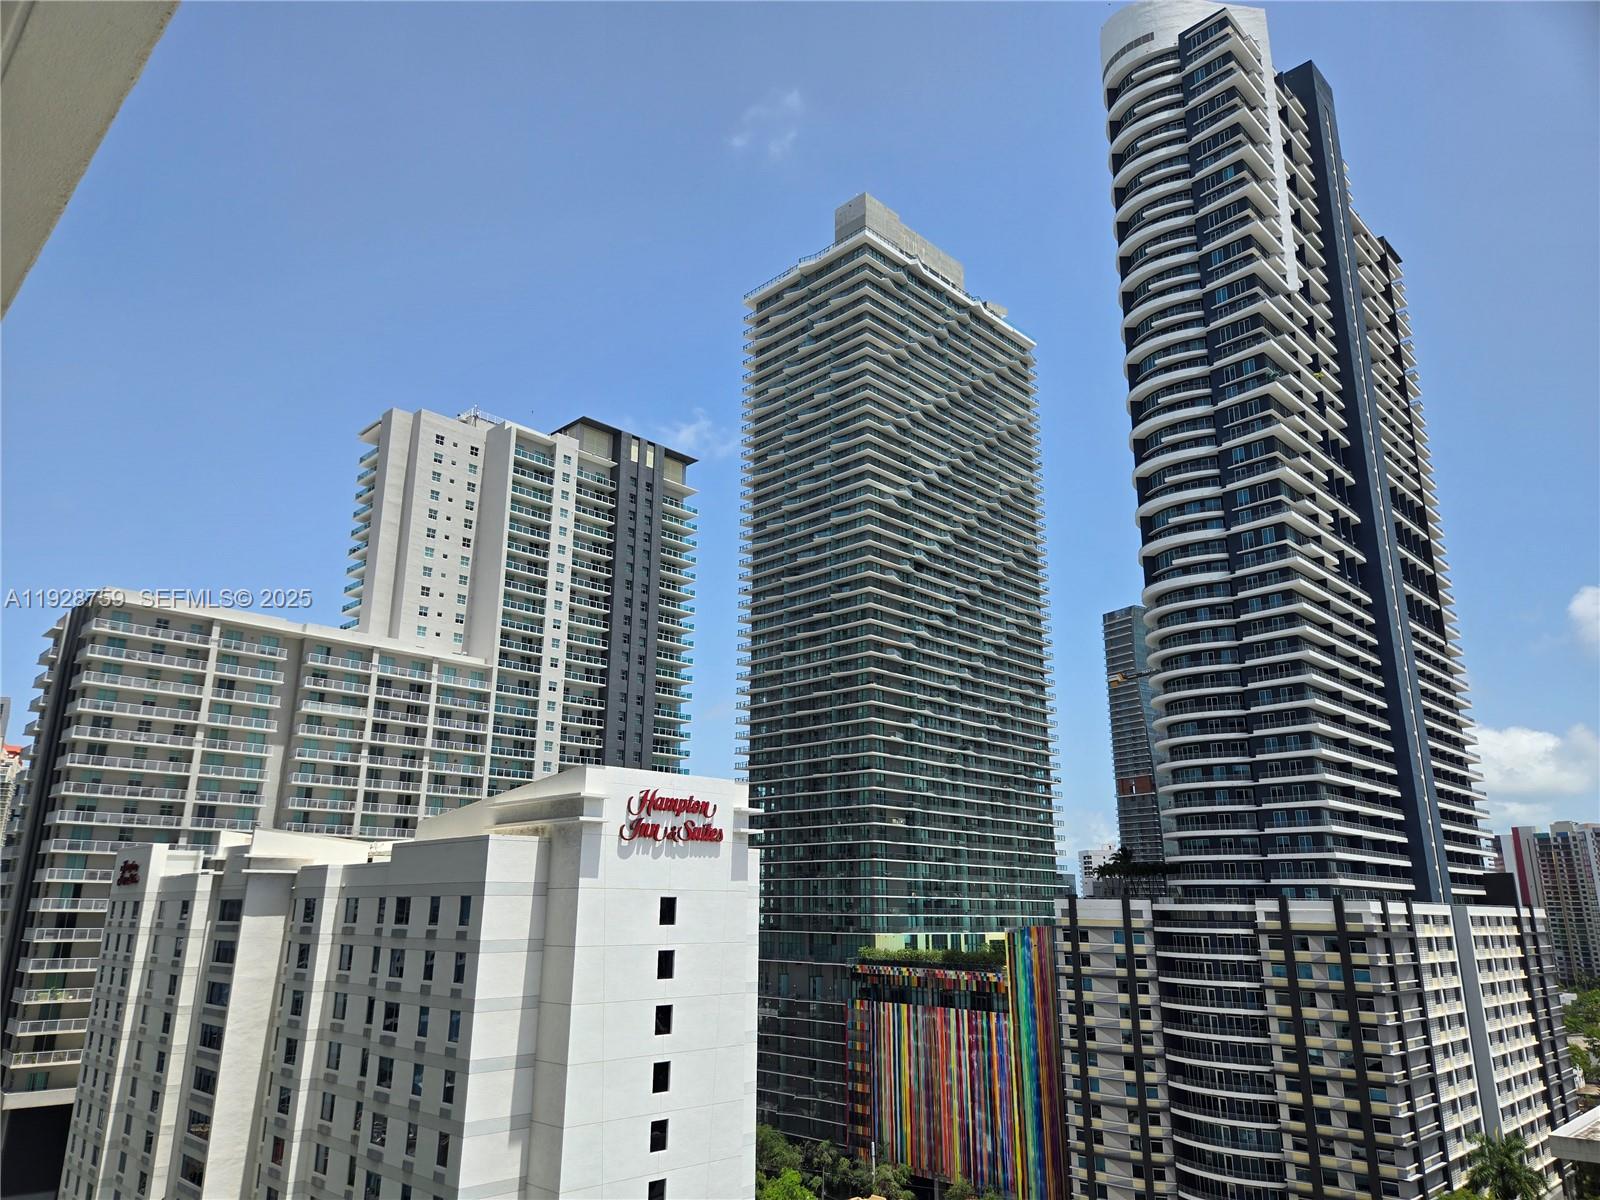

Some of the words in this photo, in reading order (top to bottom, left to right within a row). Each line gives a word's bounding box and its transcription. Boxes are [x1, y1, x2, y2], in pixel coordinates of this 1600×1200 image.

[627, 789, 717, 818] Hampton
[620, 818, 668, 841] Inn
[666, 826, 679, 842] &
[677, 820, 723, 842] Suites
